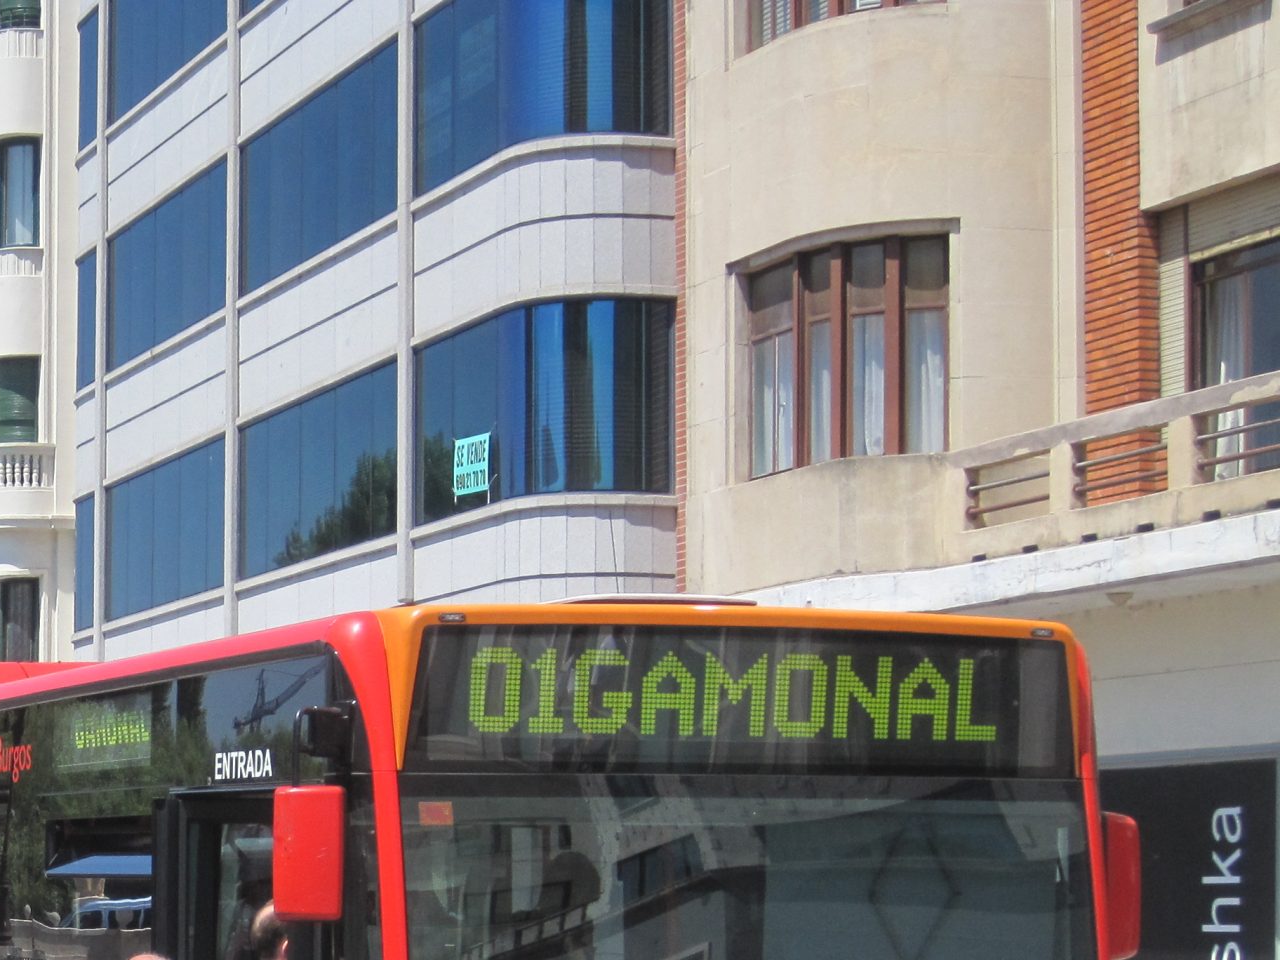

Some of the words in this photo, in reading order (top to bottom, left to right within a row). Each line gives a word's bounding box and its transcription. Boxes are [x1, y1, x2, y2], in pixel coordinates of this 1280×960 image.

[456, 445, 464, 468] SE
[467, 440, 486, 465] VENDE
[215, 749, 272, 780] ENTRADA
